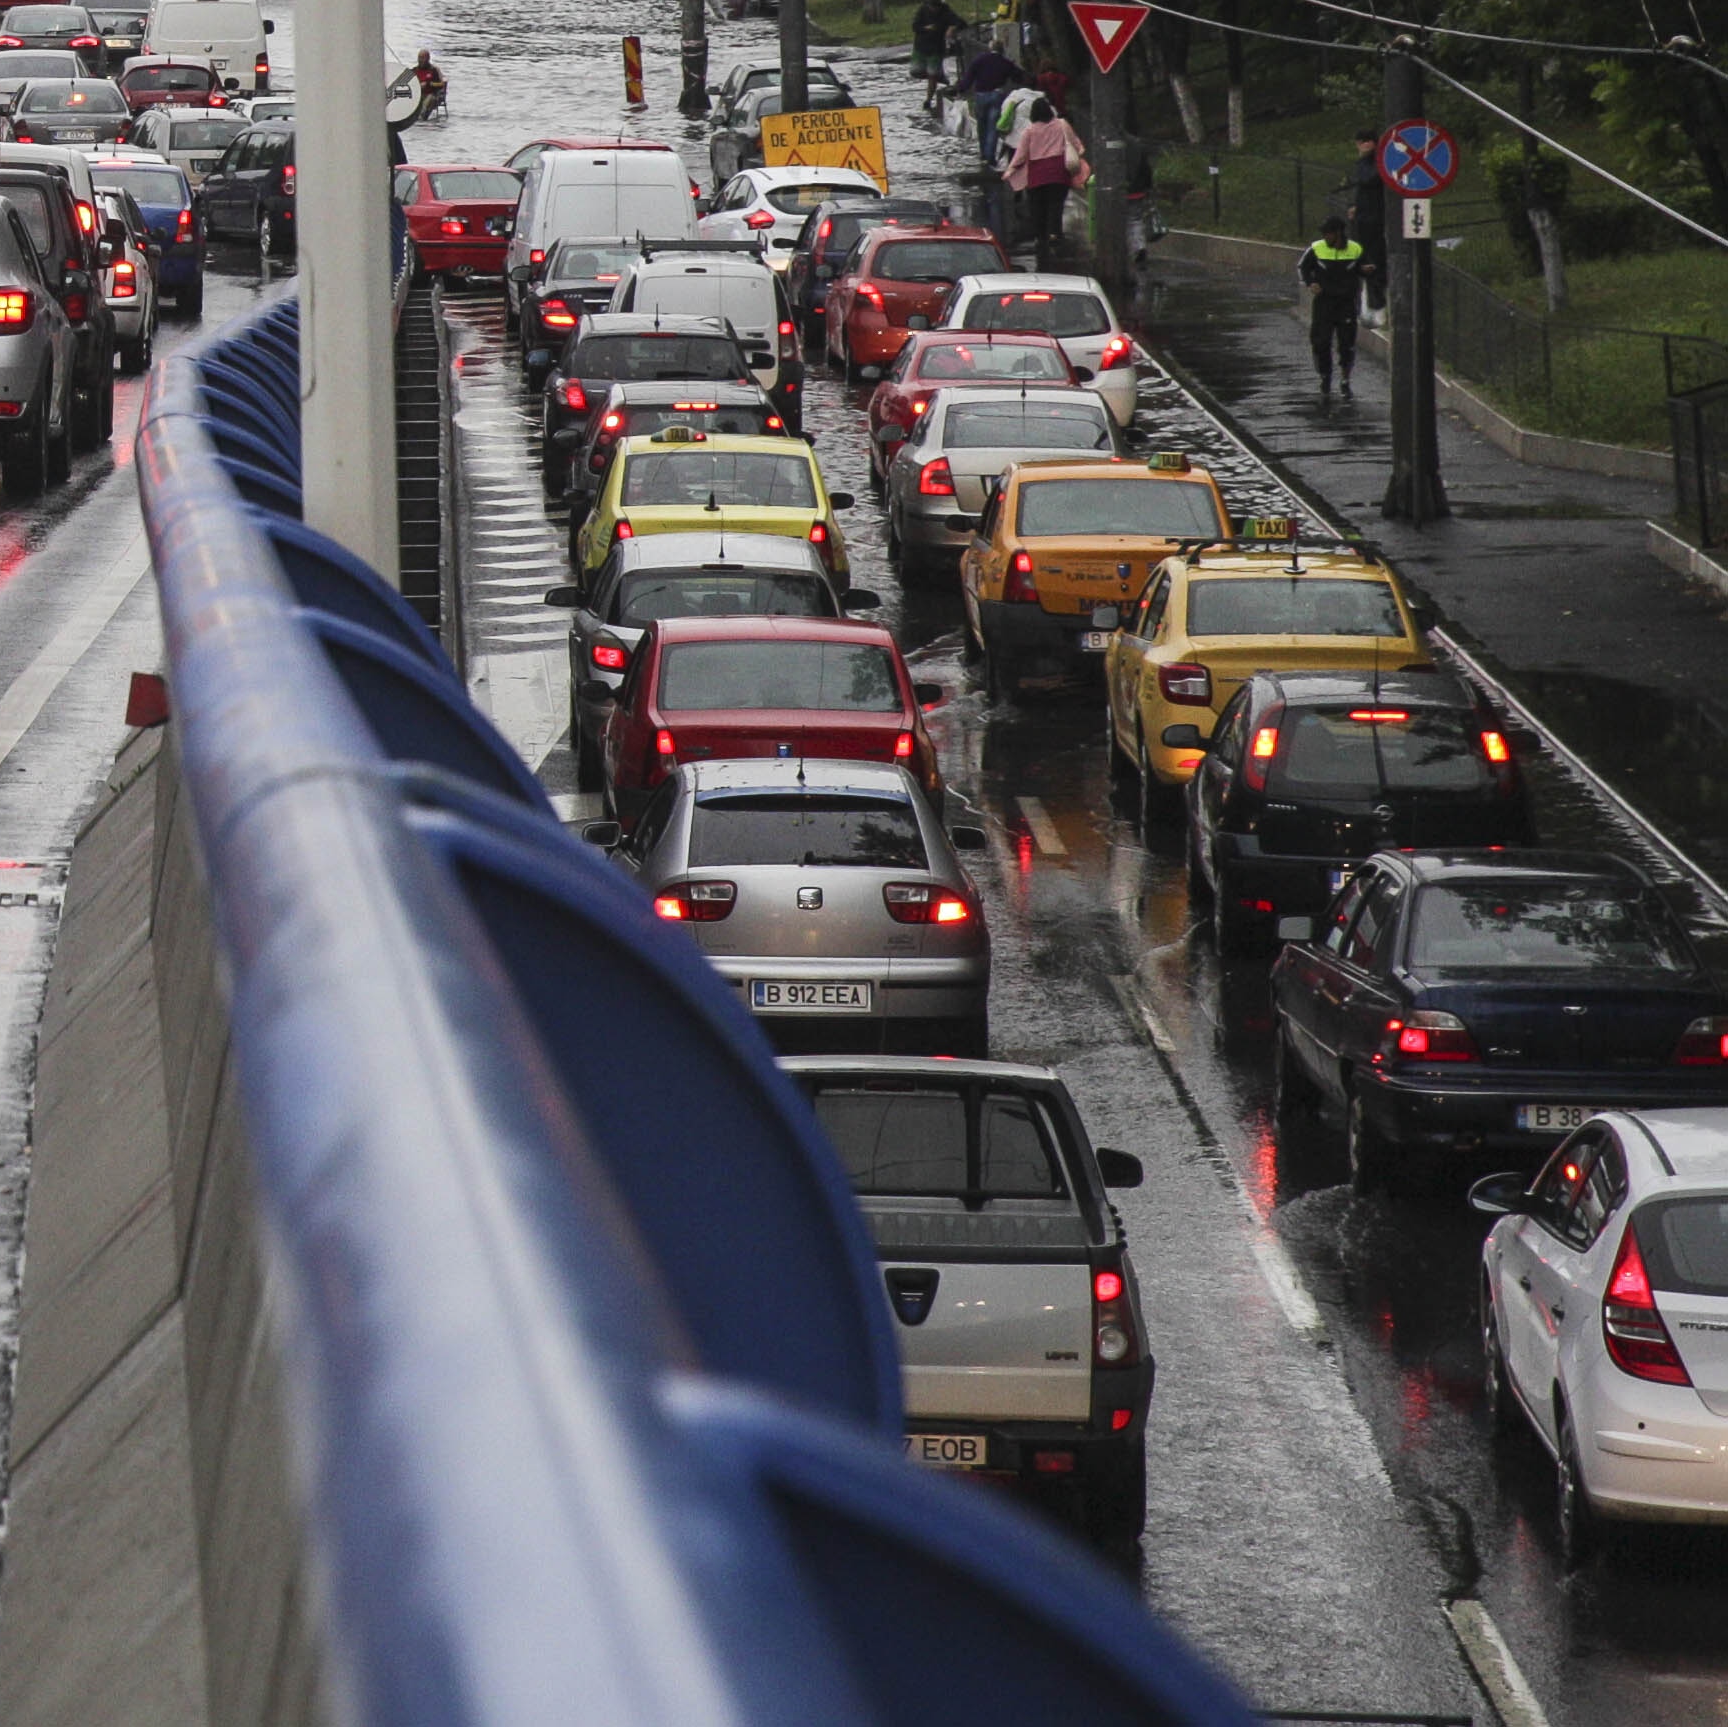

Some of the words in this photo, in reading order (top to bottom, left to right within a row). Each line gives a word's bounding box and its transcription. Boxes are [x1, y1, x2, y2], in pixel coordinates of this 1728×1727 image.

[792, 112, 849, 129] PERICOL
[770, 133, 788, 147] DE
[798, 125, 873, 145] ACCIDENTE
[670, 428, 691, 441] TAXI
[1256, 521, 1288, 536] TAXI
[767, 985, 780, 1003] B
[787, 985, 816, 1004] 912
[822, 985, 861, 1004] EEA
[1536, 1107, 1550, 1126] B
[1558, 1107, 1583, 1127] 38
[923, 1438, 977, 1461] EOB
